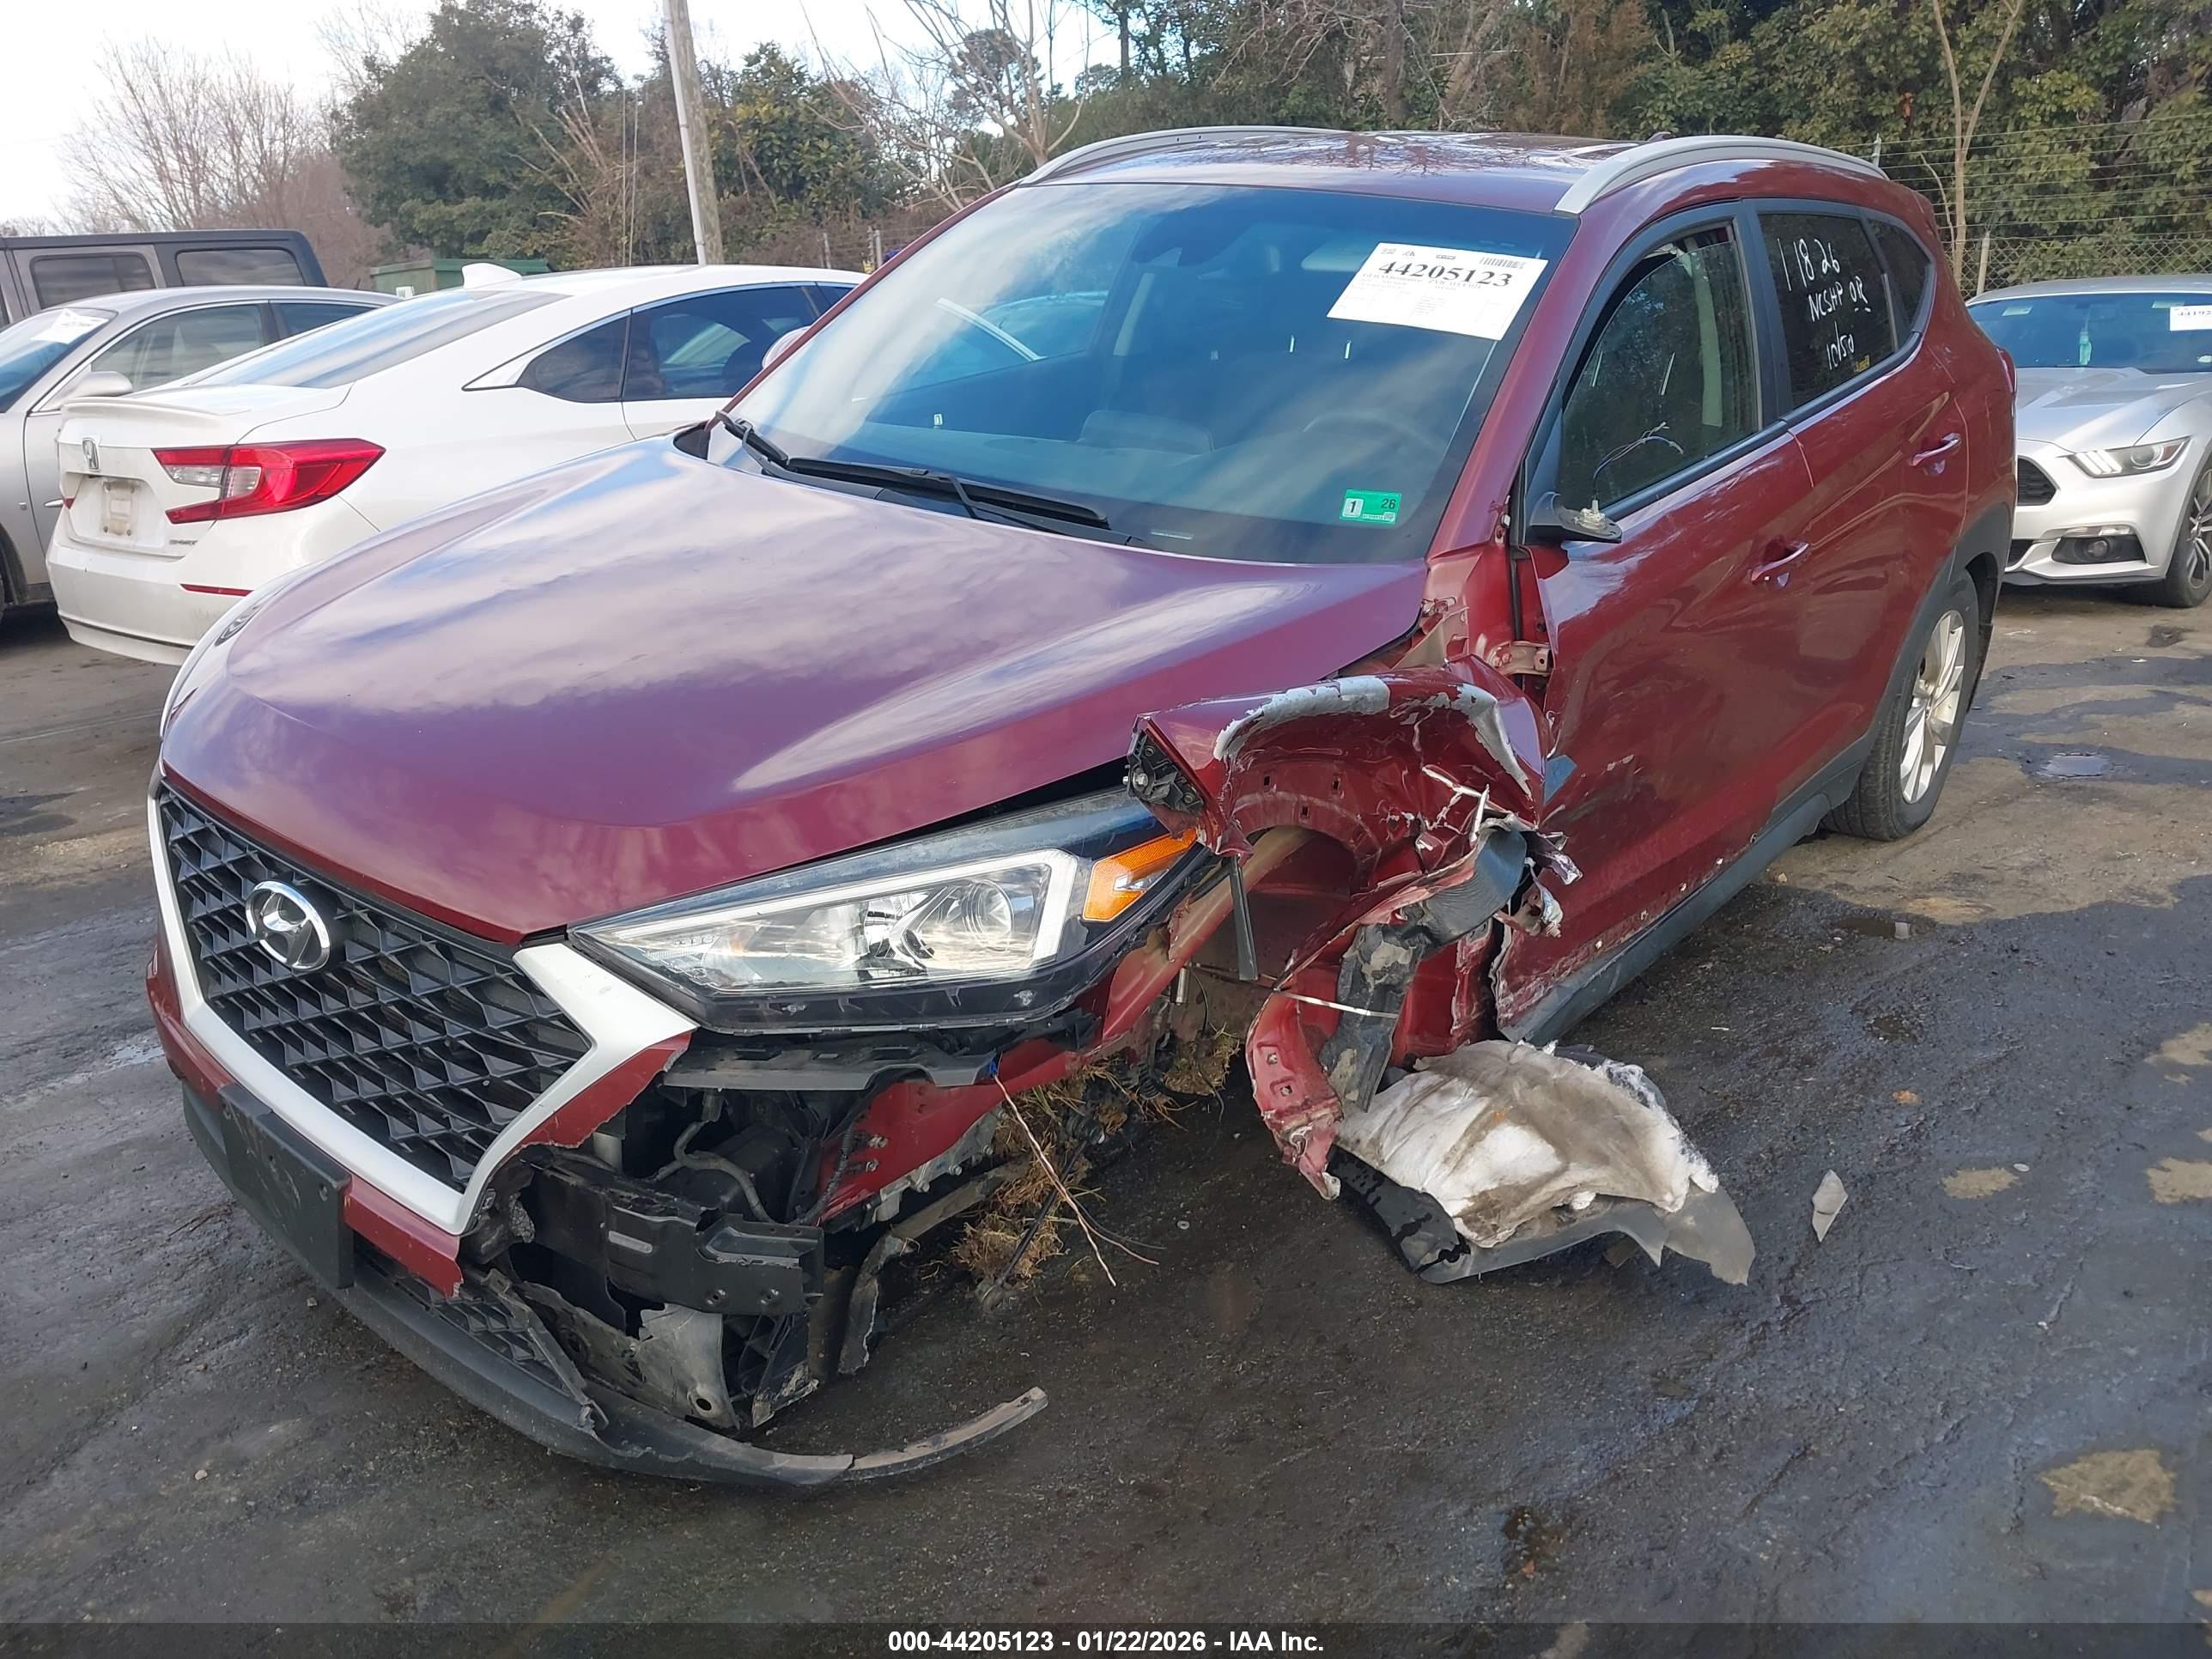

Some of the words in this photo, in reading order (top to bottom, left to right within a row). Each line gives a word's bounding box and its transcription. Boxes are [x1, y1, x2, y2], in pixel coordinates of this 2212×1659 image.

[1379, 261, 1513, 287] 44205123
[1793, 238, 1815, 289] 18
[1814, 238, 1841, 275] 26
[1808, 280, 1844, 322] NCSHP
[1826, 319, 1855, 371] 10/50
[1350, 500, 1357, 513] 1
[1381, 498, 1396, 509] 26
